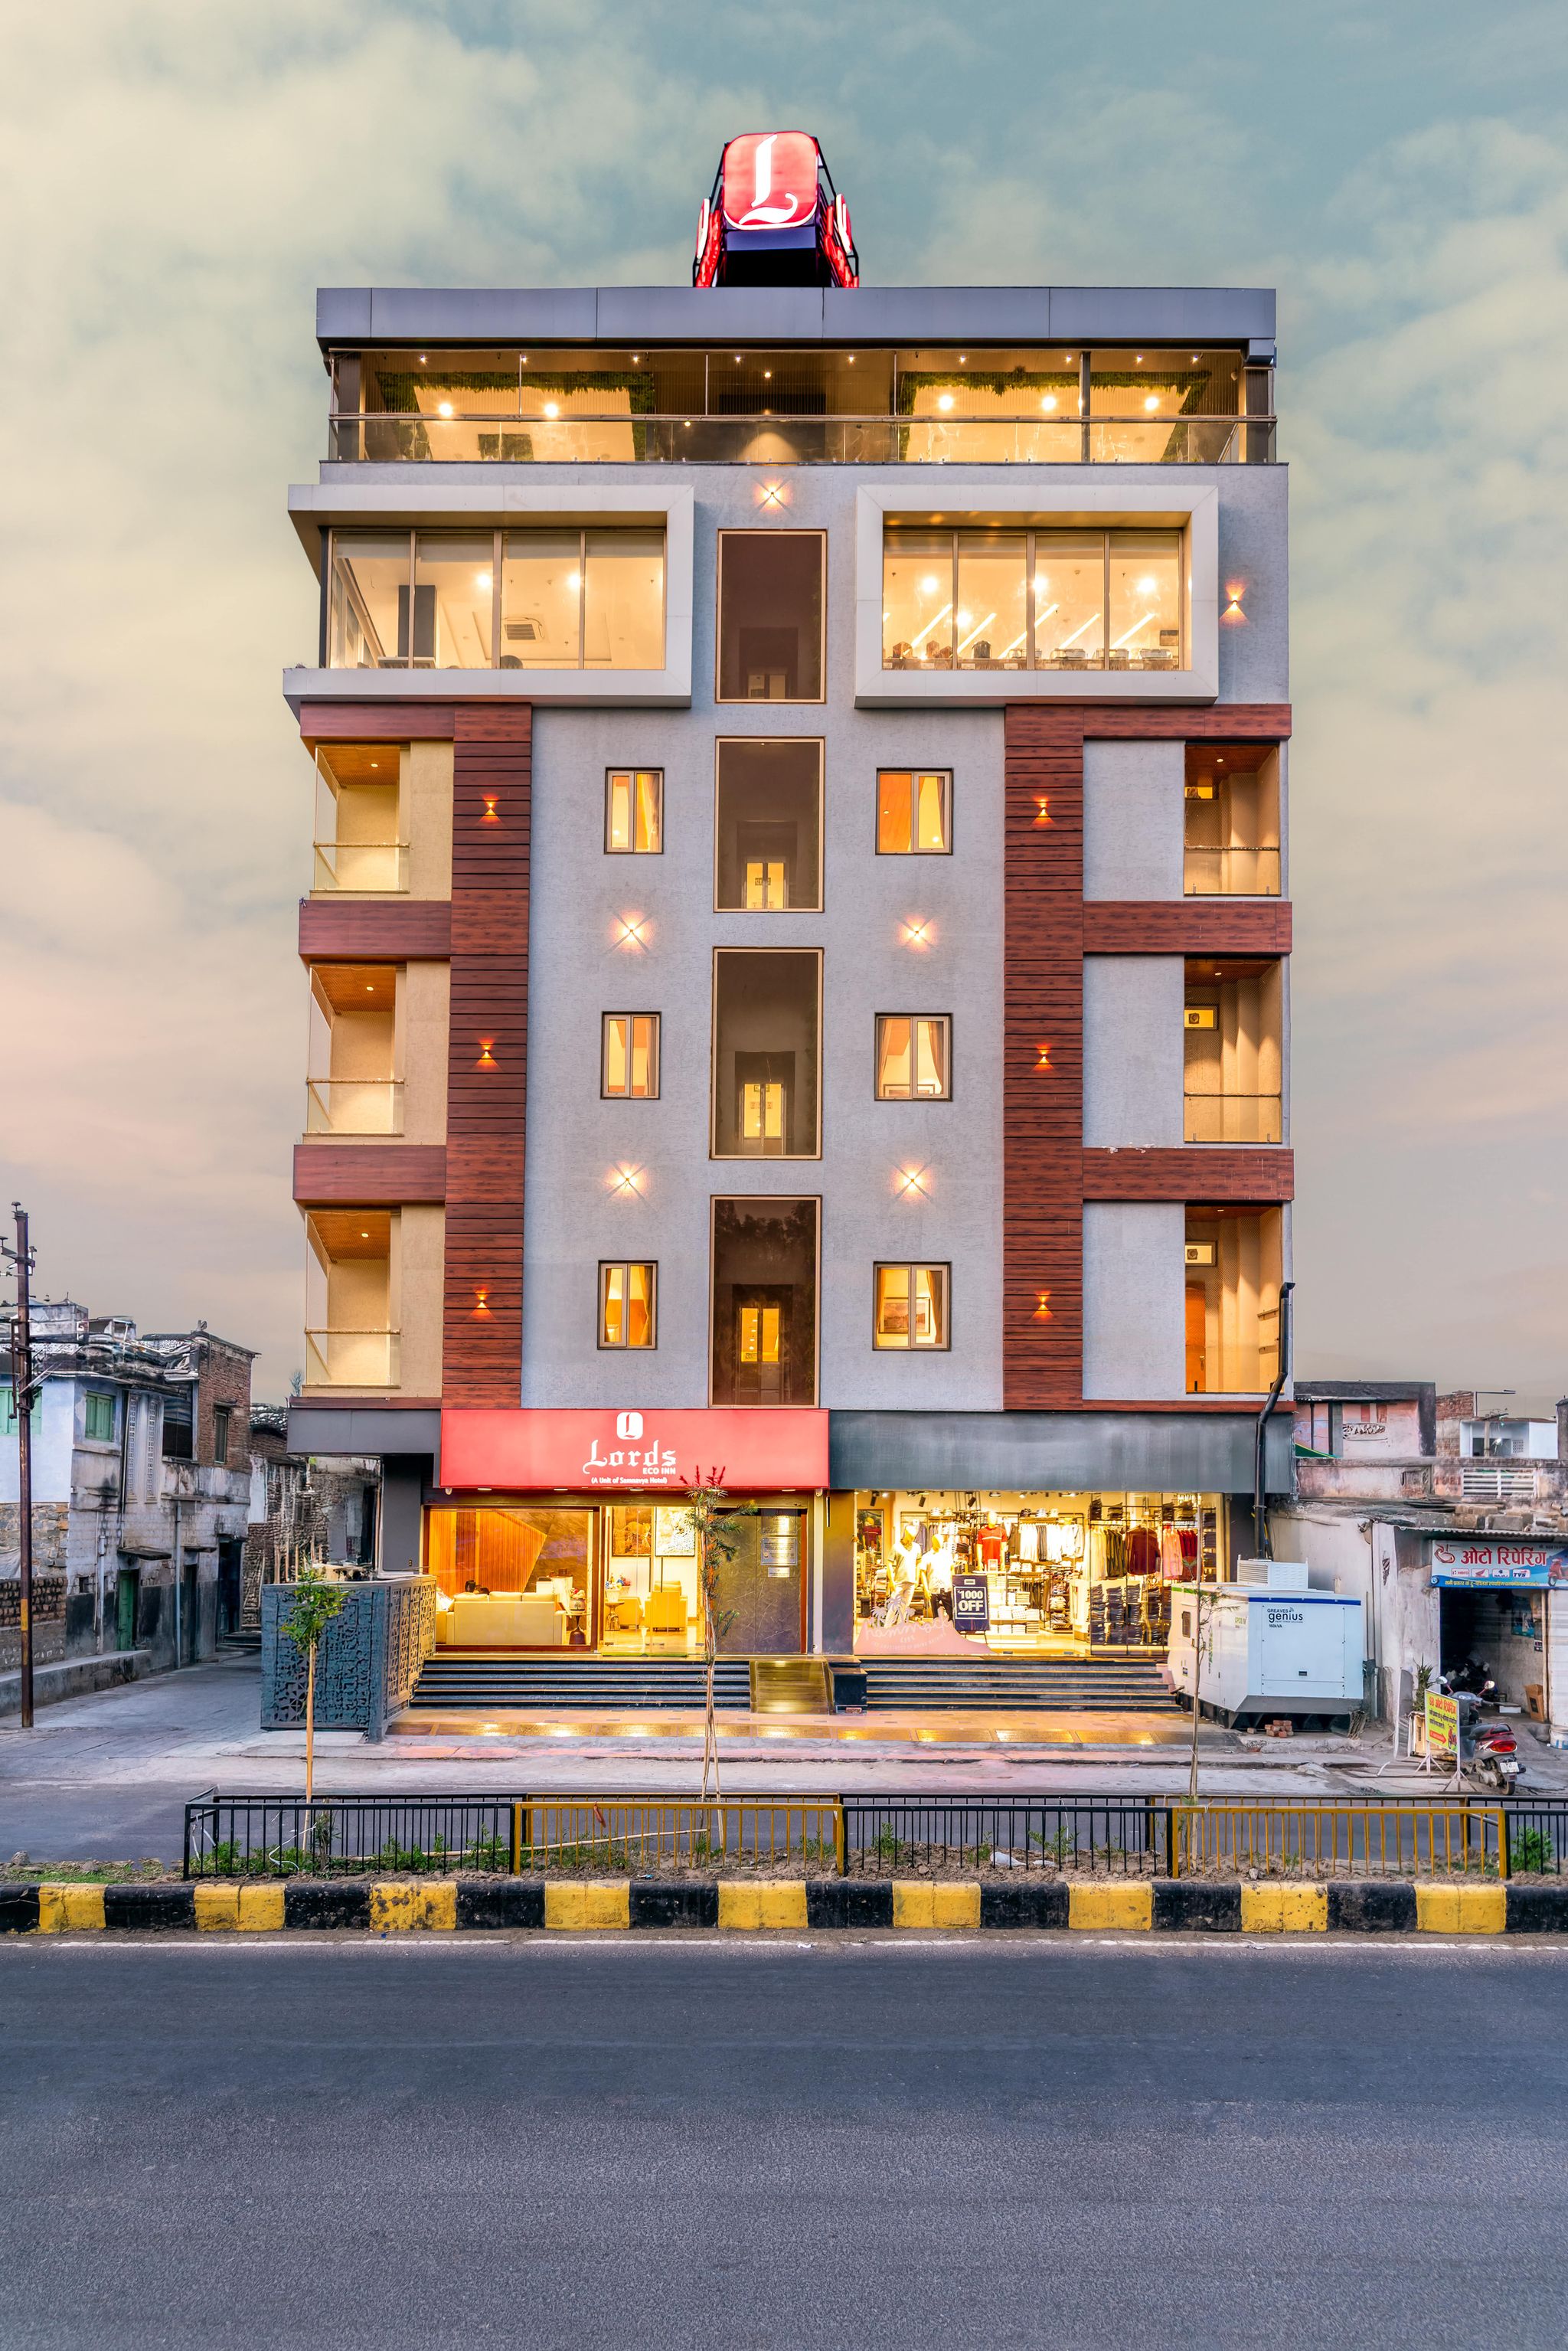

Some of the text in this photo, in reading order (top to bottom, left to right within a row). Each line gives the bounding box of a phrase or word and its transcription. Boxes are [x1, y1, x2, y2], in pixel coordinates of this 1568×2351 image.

[738, 133, 799, 225] L
[582, 1440, 677, 1474] Lords
[958, 1600, 984, 1611] OFF
[1268, 1610, 1303, 1623] genius
